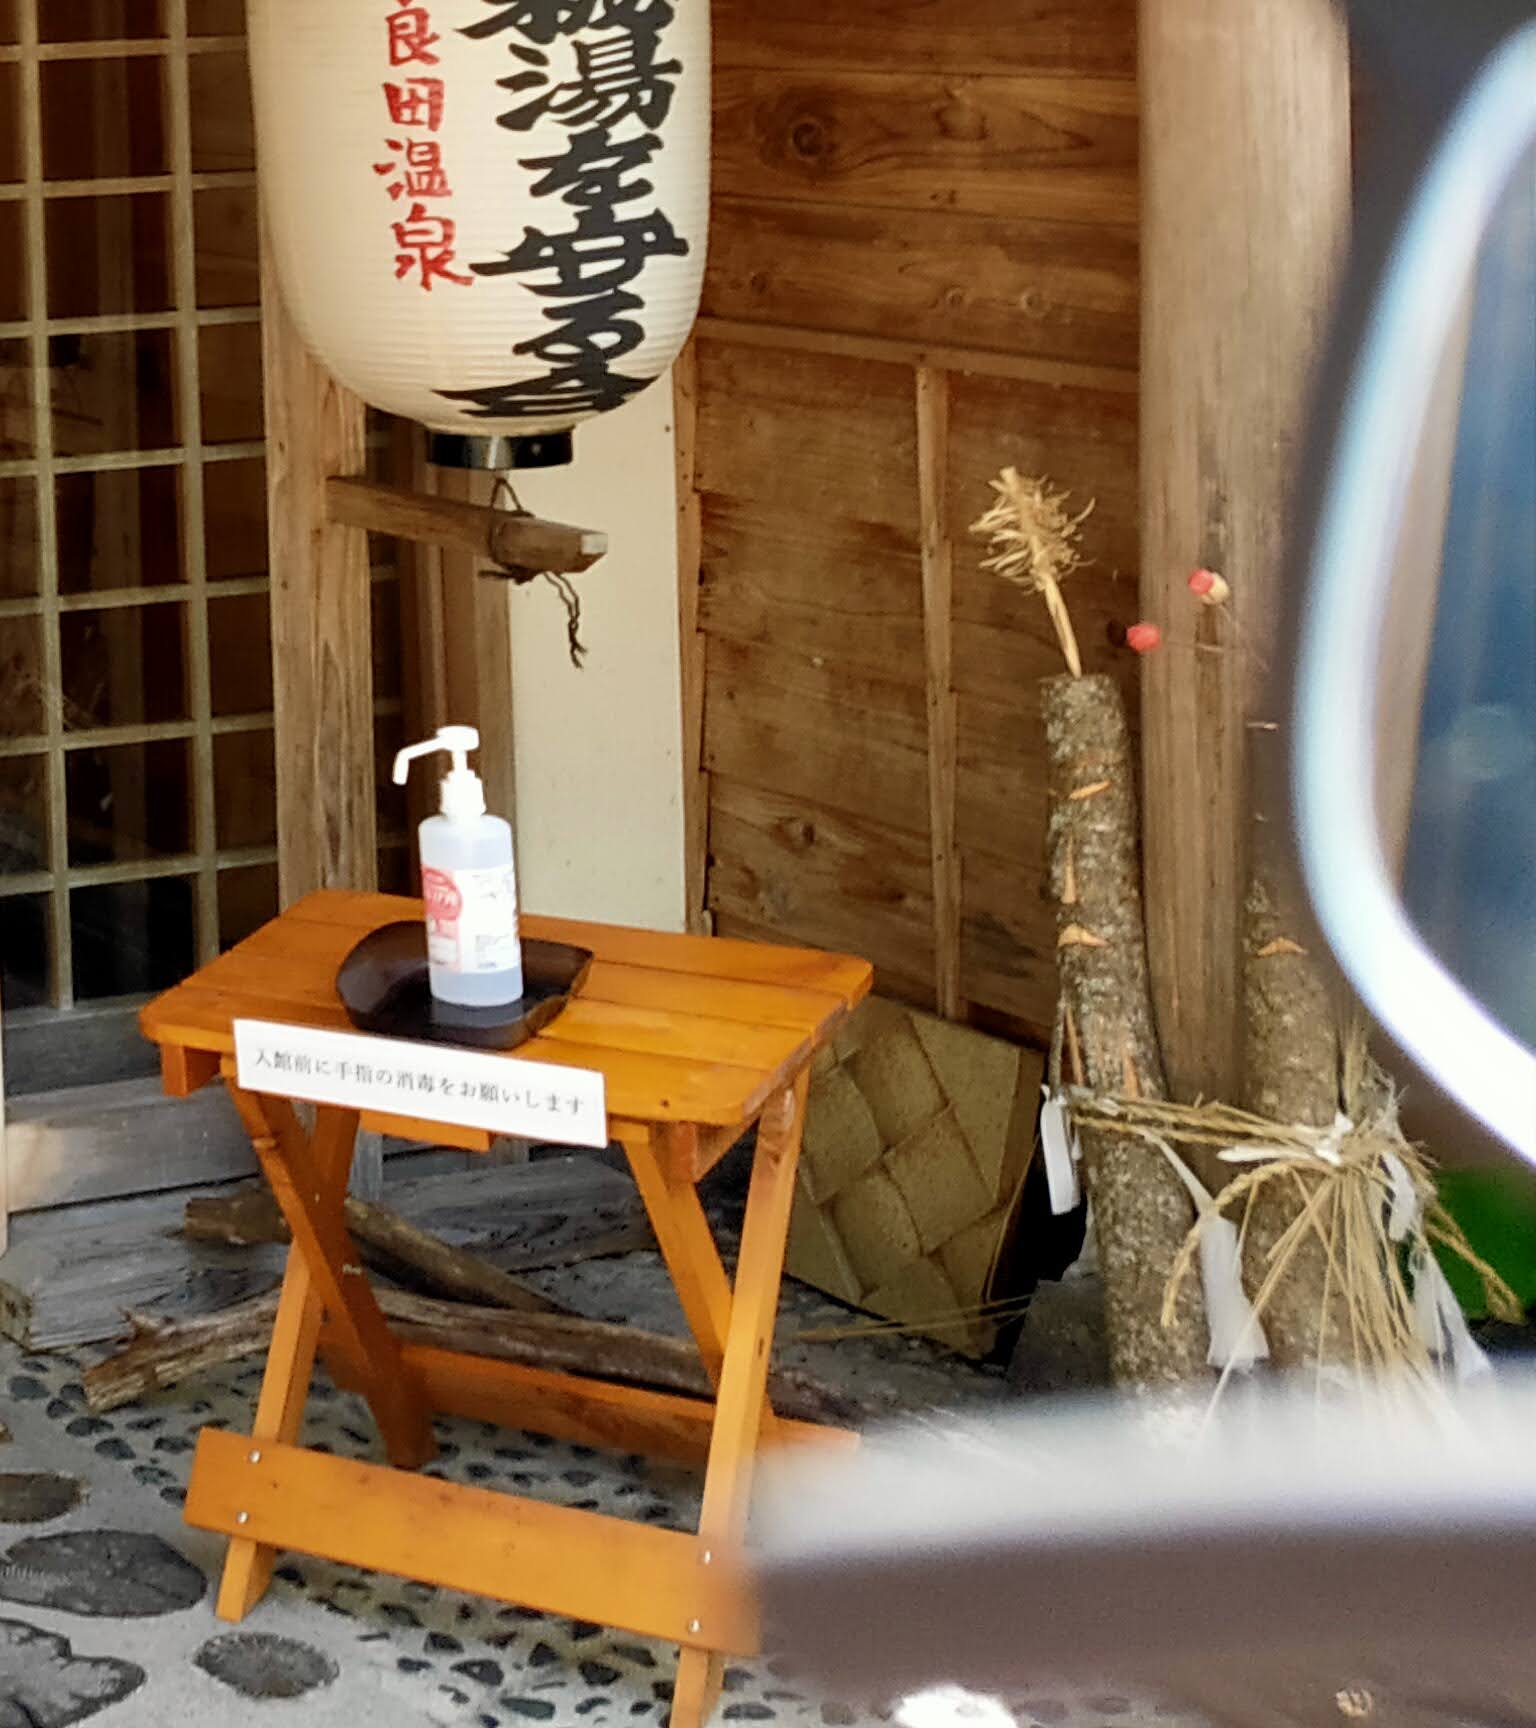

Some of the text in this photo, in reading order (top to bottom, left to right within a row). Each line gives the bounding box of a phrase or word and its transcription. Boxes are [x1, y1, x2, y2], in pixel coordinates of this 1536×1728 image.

[254, 1047, 585, 1117] 入館前に手指の消毒をお願いします
